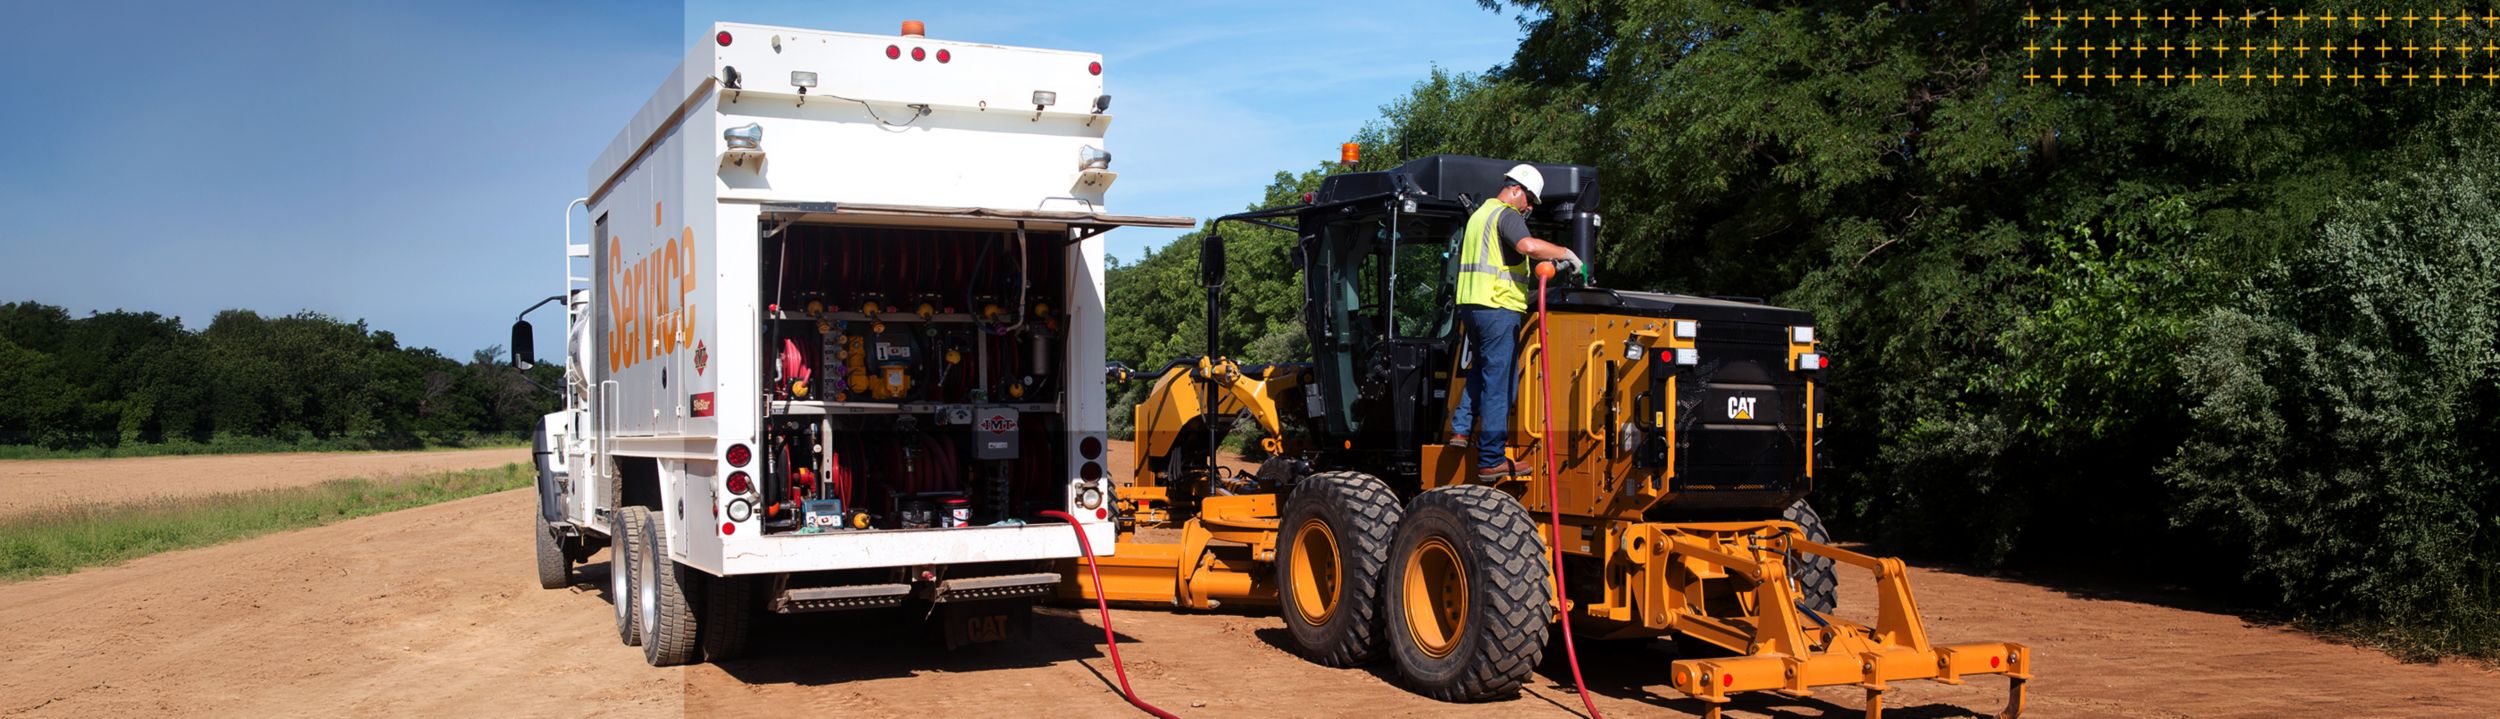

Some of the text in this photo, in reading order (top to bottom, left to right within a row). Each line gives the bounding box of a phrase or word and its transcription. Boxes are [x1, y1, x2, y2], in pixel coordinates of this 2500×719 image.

[609, 201, 696, 374] Service
[1728, 396, 1756, 420] CAT
[984, 418, 1013, 430] IMT
[968, 615, 1007, 642] CAT
